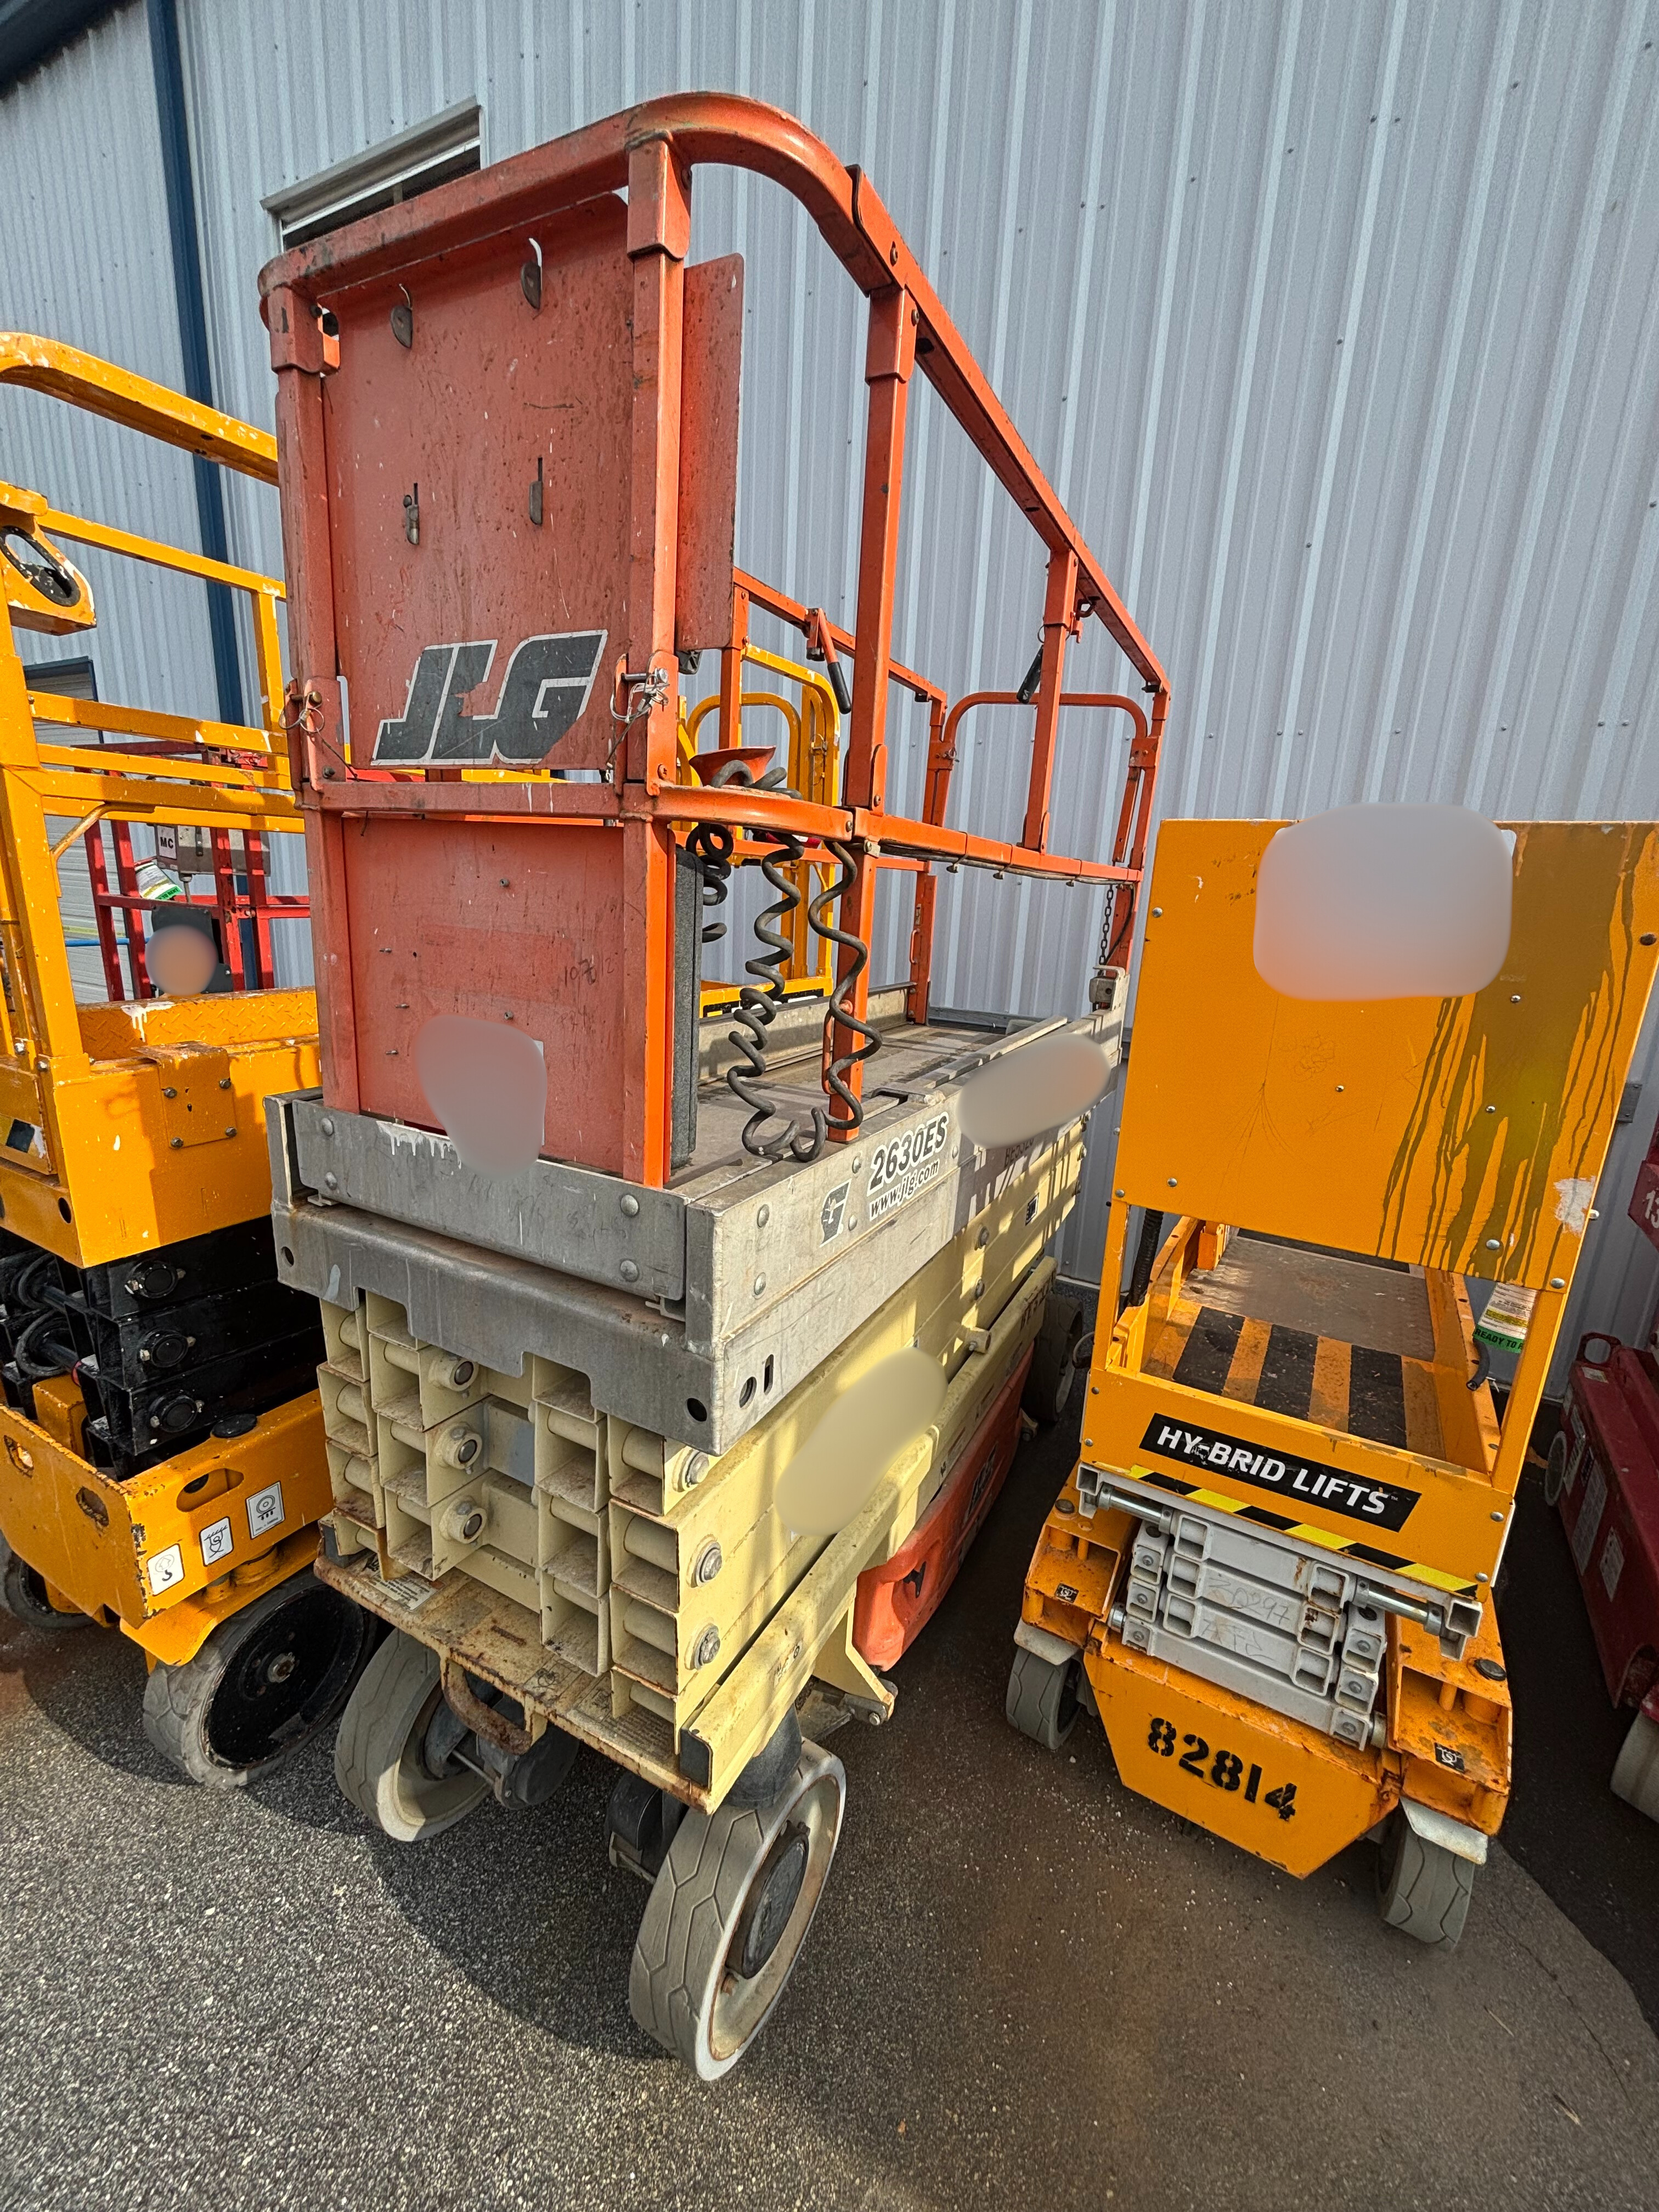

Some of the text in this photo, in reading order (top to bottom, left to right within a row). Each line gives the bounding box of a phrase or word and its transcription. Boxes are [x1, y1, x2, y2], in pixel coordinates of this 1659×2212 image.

[371, 629, 607, 765] JLG
[160, 836, 173, 849] MC
[868, 1114, 948, 1193] 2630ES
[871, 1160, 939, 1218] www.jlg.com
[1475, 1328, 1505, 1346] READY
[1505, 1339, 1517, 1348] TO
[1157, 1425, 1286, 1482] HY-BRID
[1292, 1468, 1389, 1515] LIFTS
[1148, 1717, 1297, 1822] 82814
